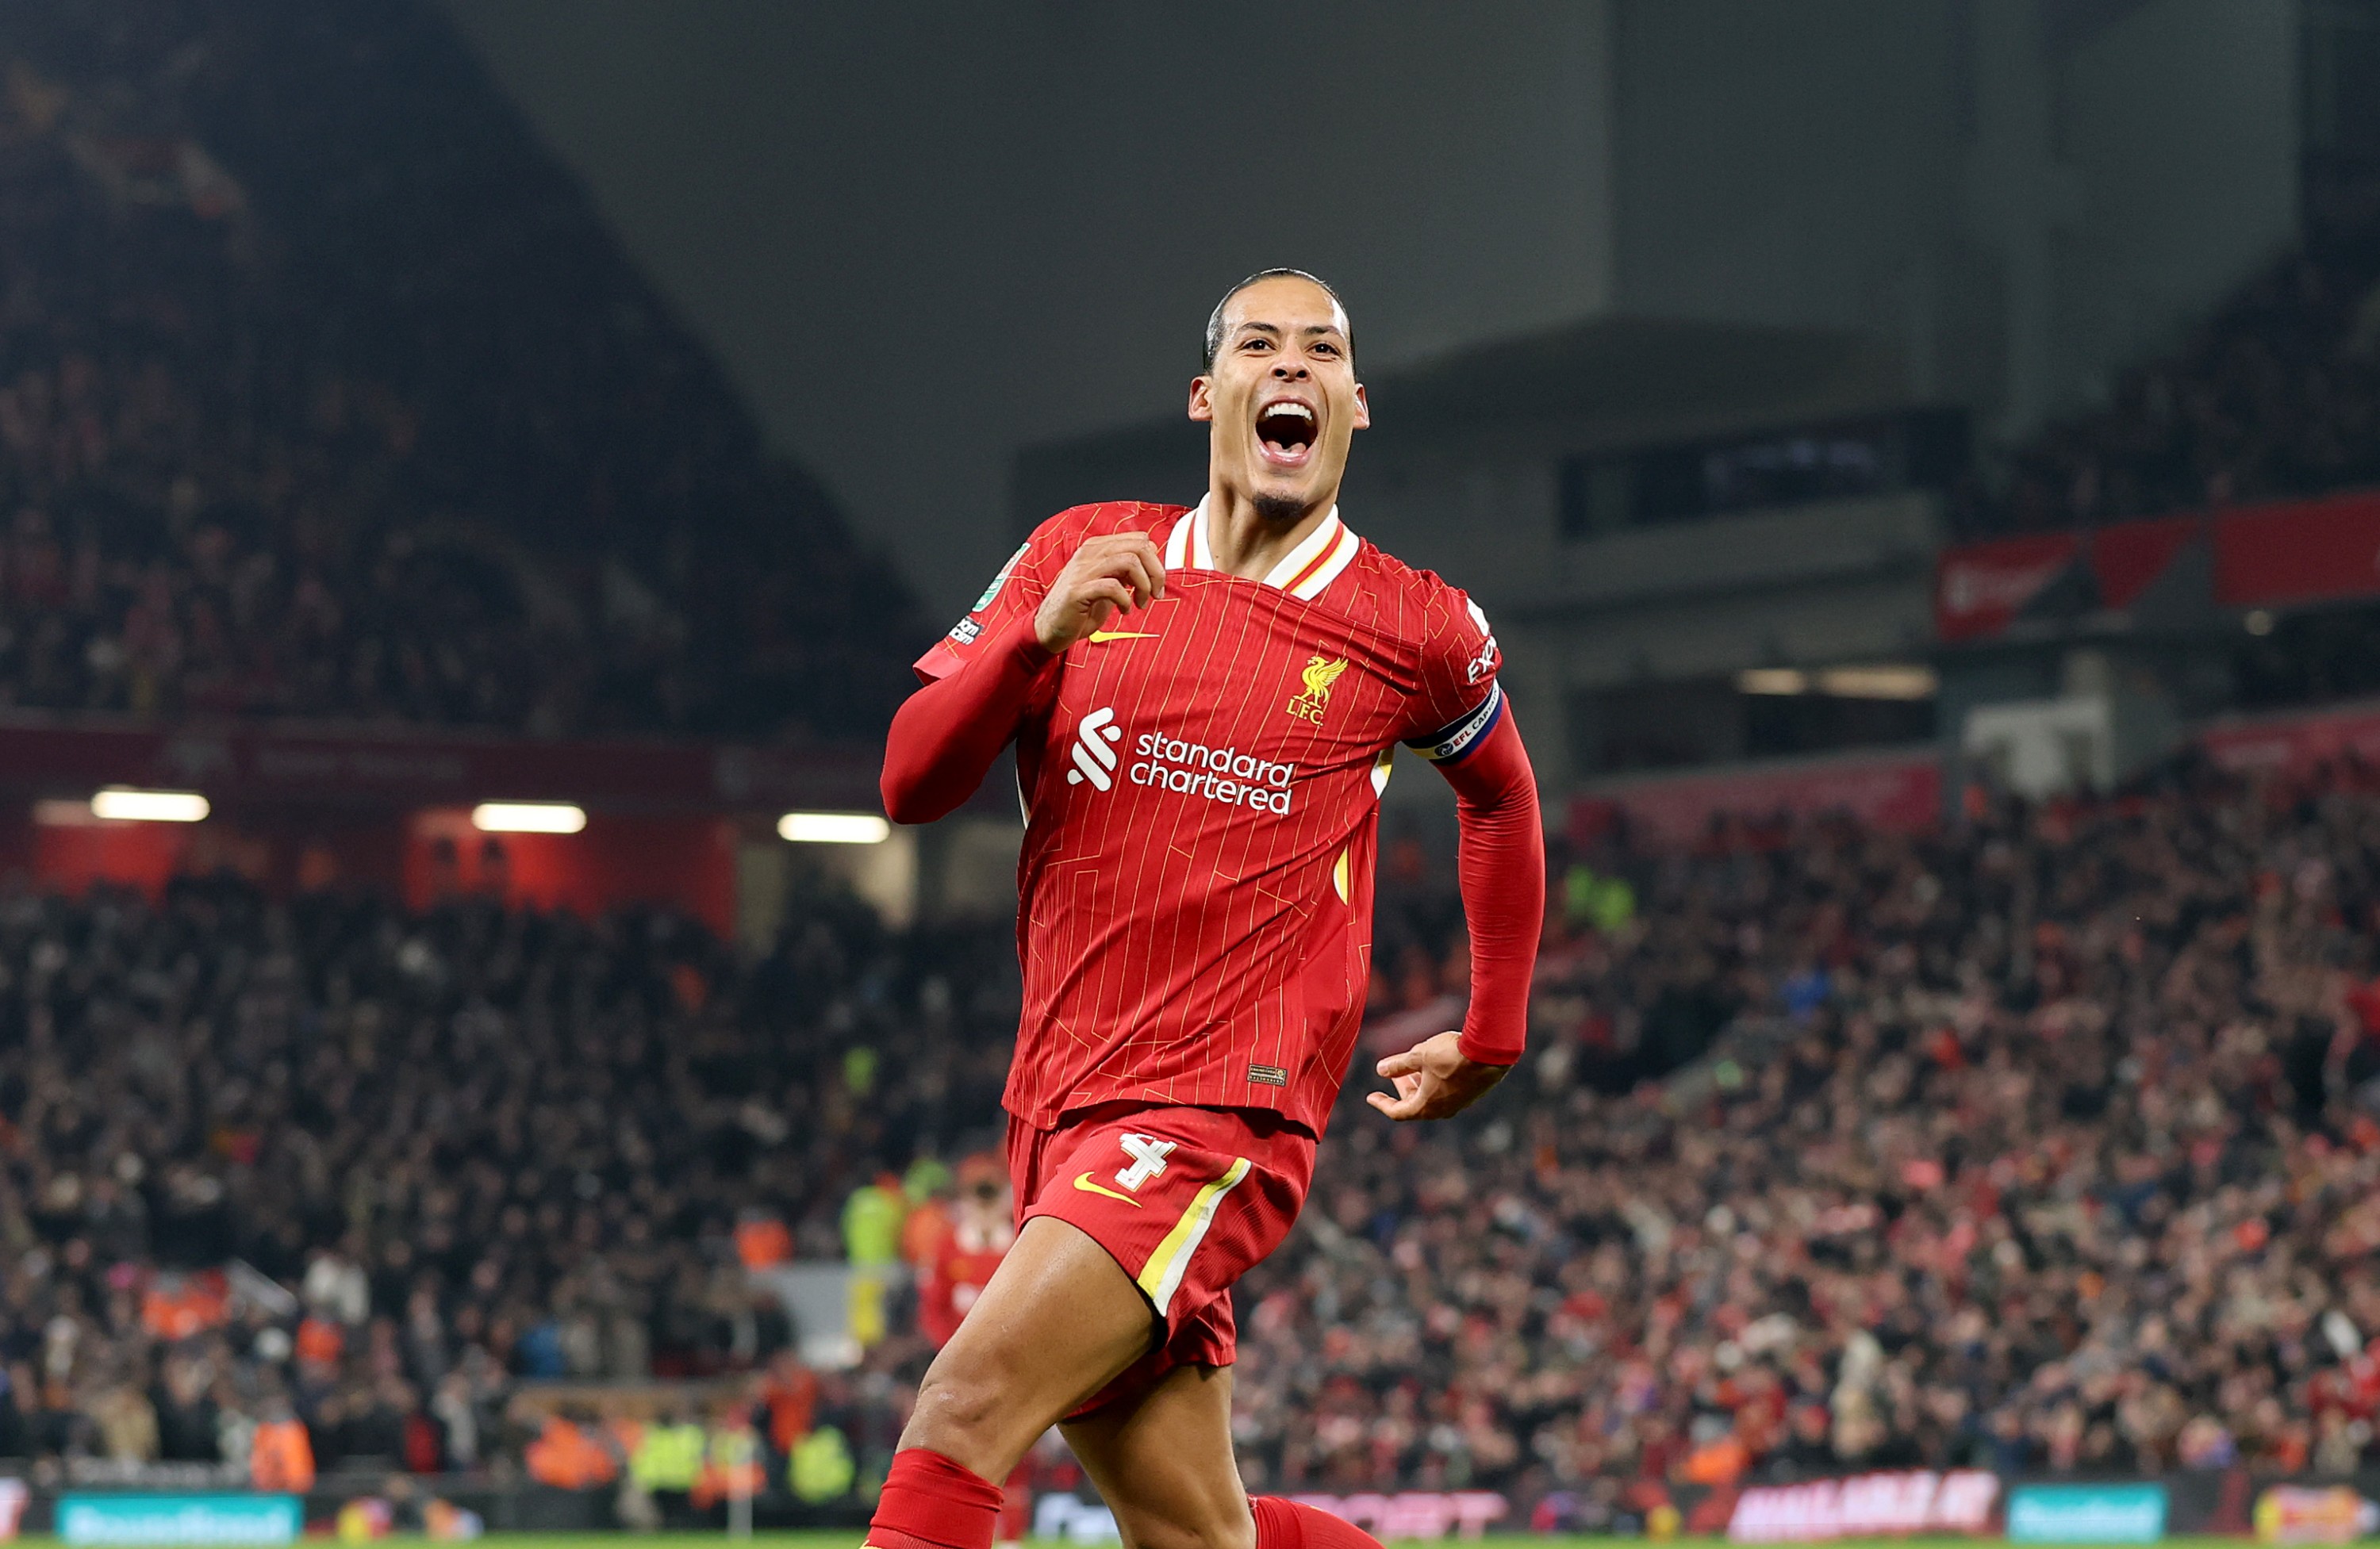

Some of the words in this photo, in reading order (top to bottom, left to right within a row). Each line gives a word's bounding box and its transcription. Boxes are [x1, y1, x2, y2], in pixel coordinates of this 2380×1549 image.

[1286, 699, 1324, 726] L.F.C.
[1453, 730, 1472, 747] EFL
[1135, 731, 1294, 788] standard
[1130, 760, 1292, 815] chartered
[1114, 1133, 1178, 1193] 4
